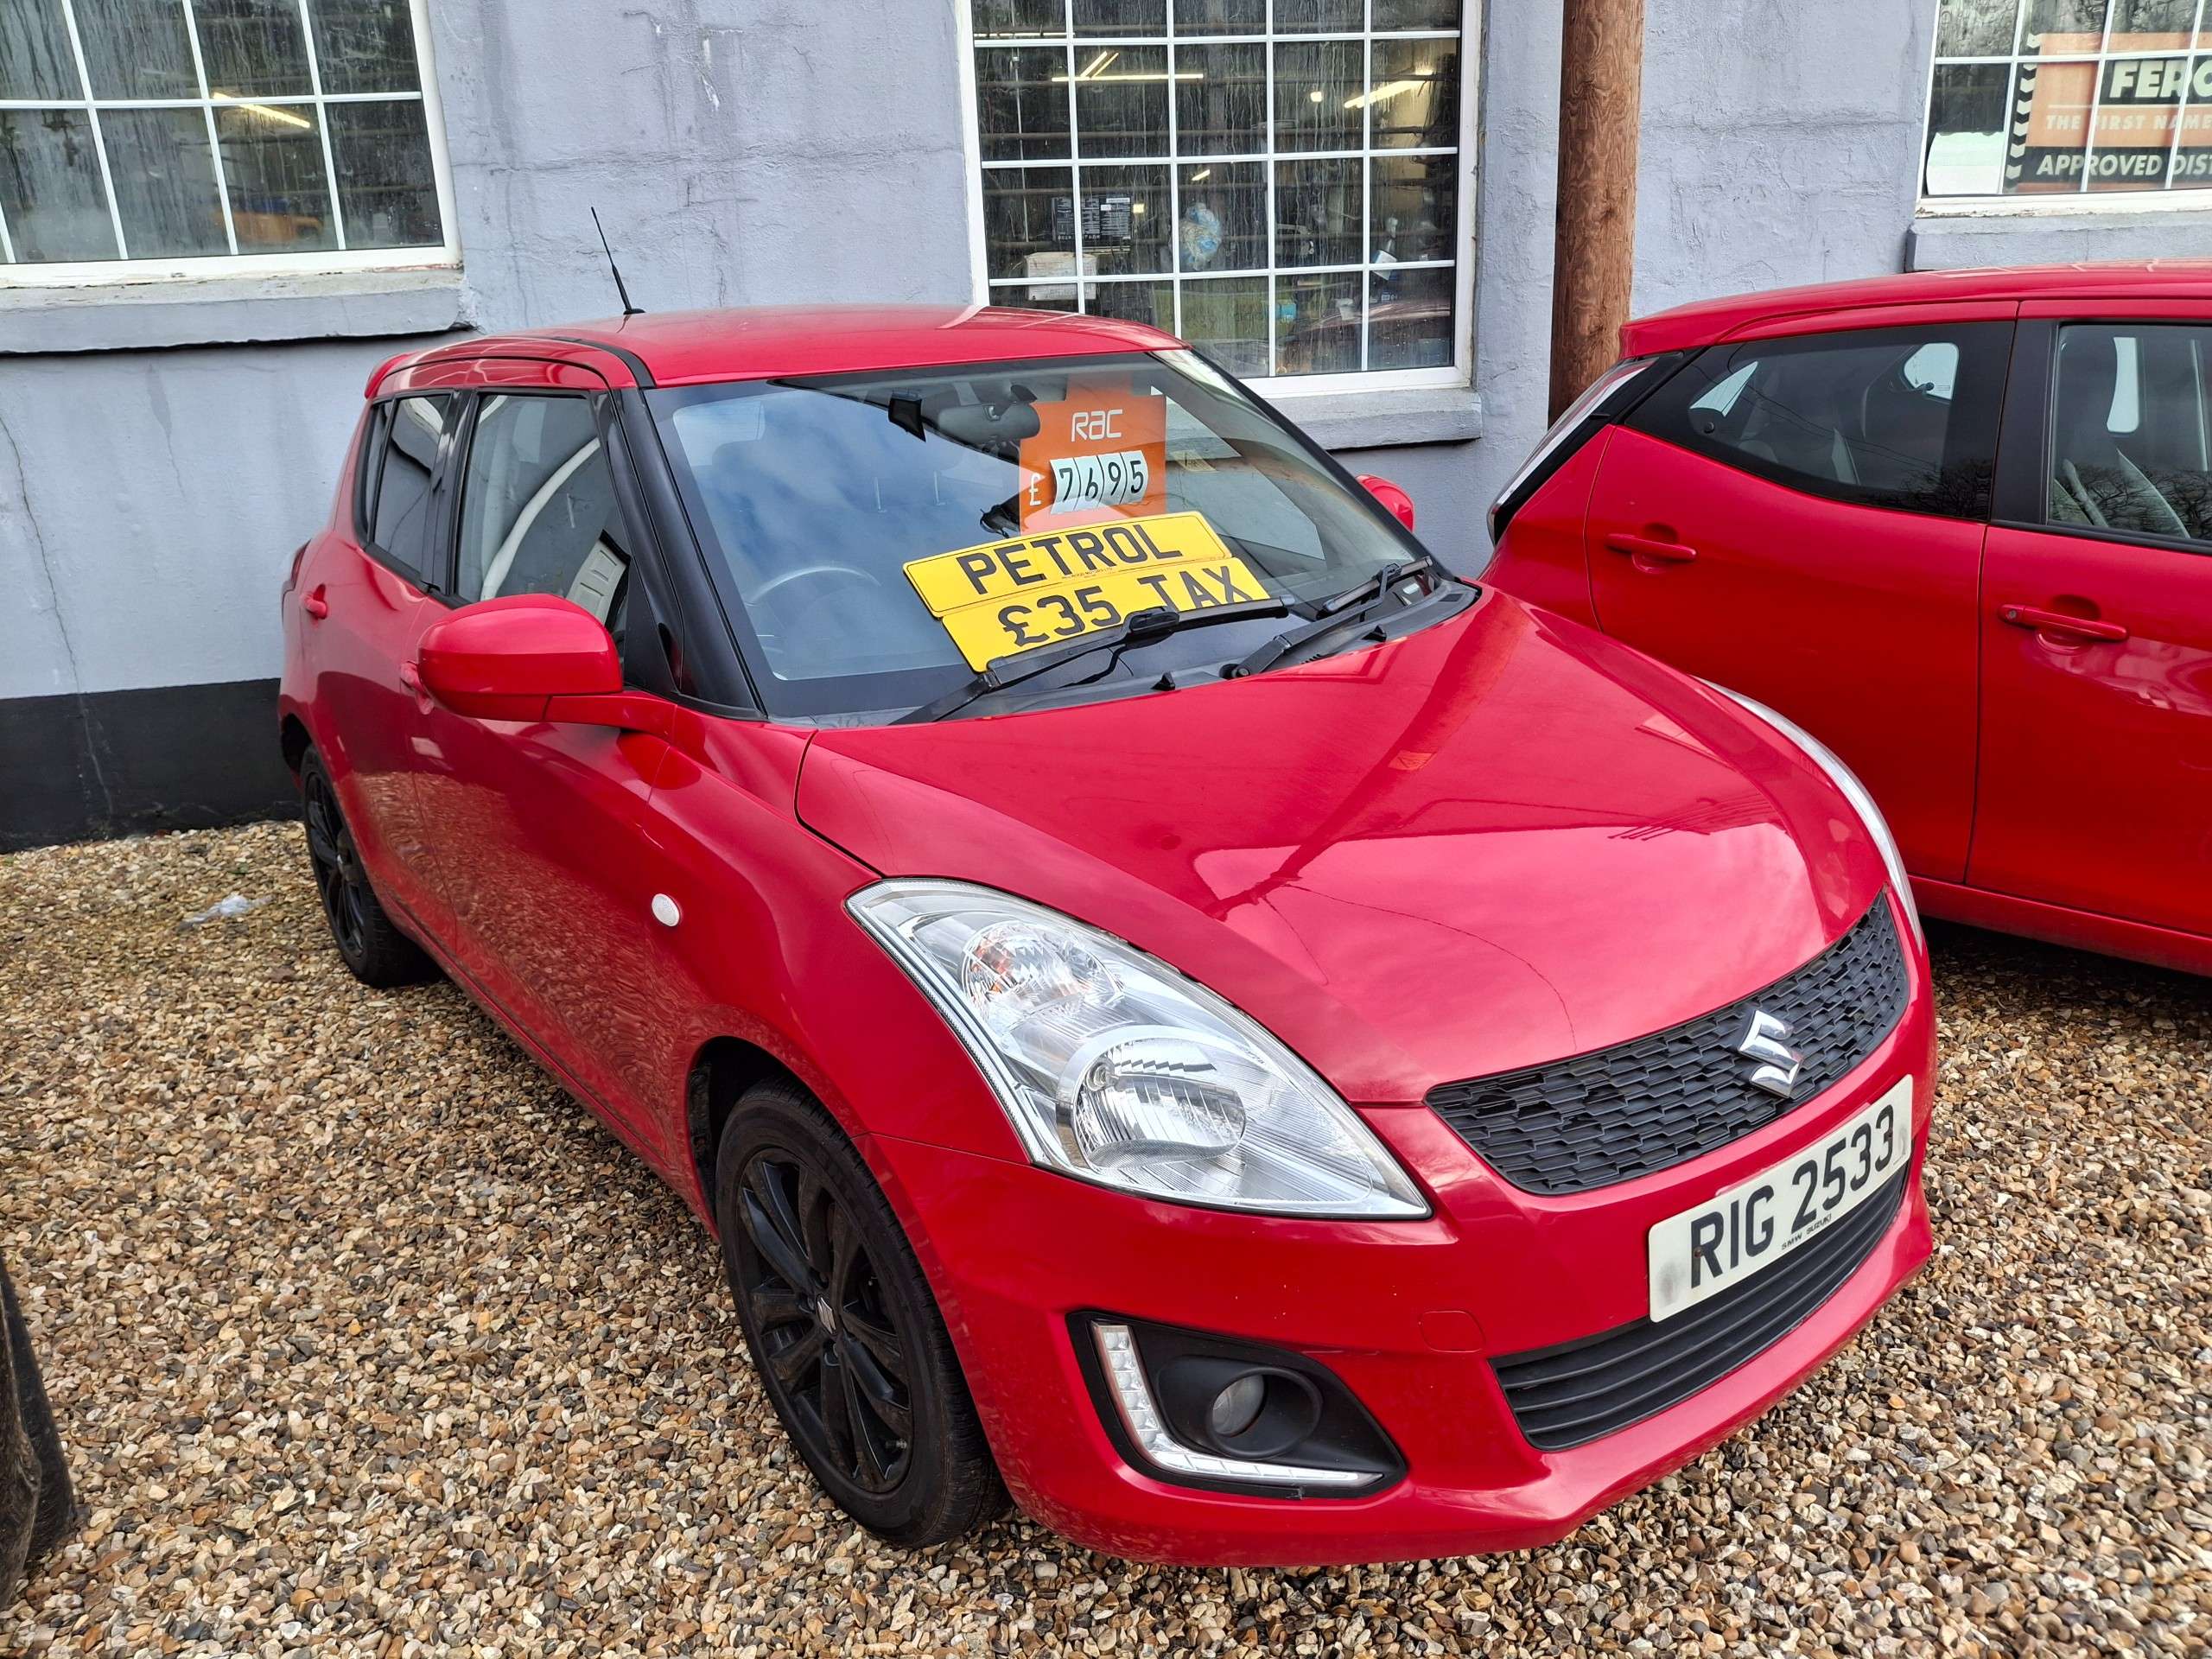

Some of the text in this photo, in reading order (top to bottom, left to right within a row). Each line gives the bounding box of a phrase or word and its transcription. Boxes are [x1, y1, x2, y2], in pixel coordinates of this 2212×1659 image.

[2046, 115, 2081, 130] THE
[2037, 155, 2163, 175] APPROVED
[956, 524, 1182, 595] PETROL
[997, 565, 1254, 647] £35 TAX
[1690, 1104, 1894, 1289] RIG 2533
